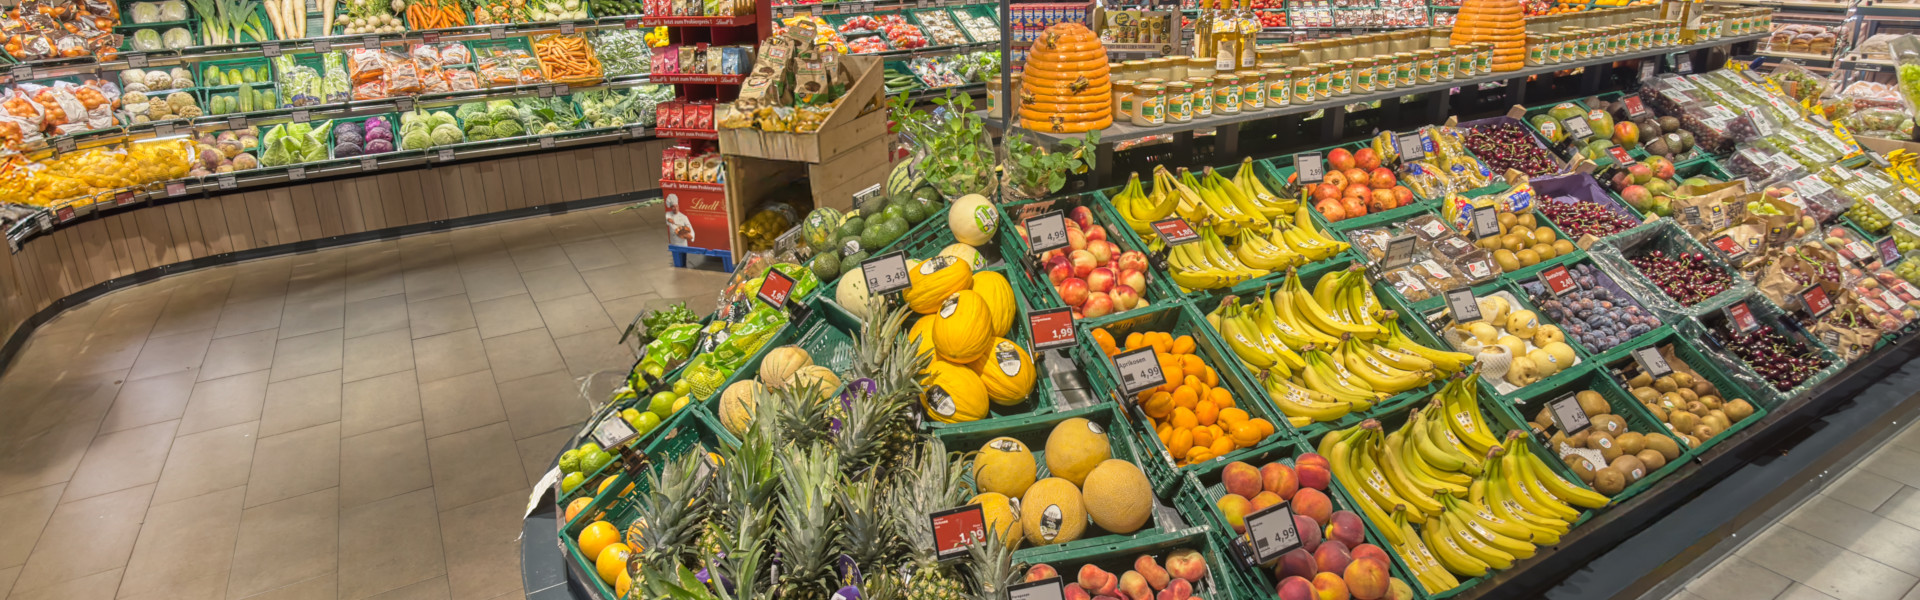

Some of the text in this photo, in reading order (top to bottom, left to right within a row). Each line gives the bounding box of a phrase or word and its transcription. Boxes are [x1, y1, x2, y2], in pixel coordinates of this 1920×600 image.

[690, 197, 719, 211] Lindt
[1047, 230, 1065, 241] 4,99
[885, 271, 906, 283] 3,49
[1560, 277, 1573, 288] 2,49
[770, 289, 785, 302] 1,99
[1052, 327, 1073, 340] 1,99
[1118, 357, 1146, 369] Aprikosen
[1140, 366, 1159, 379] 4,99
[1275, 527, 1295, 543] 4,99
